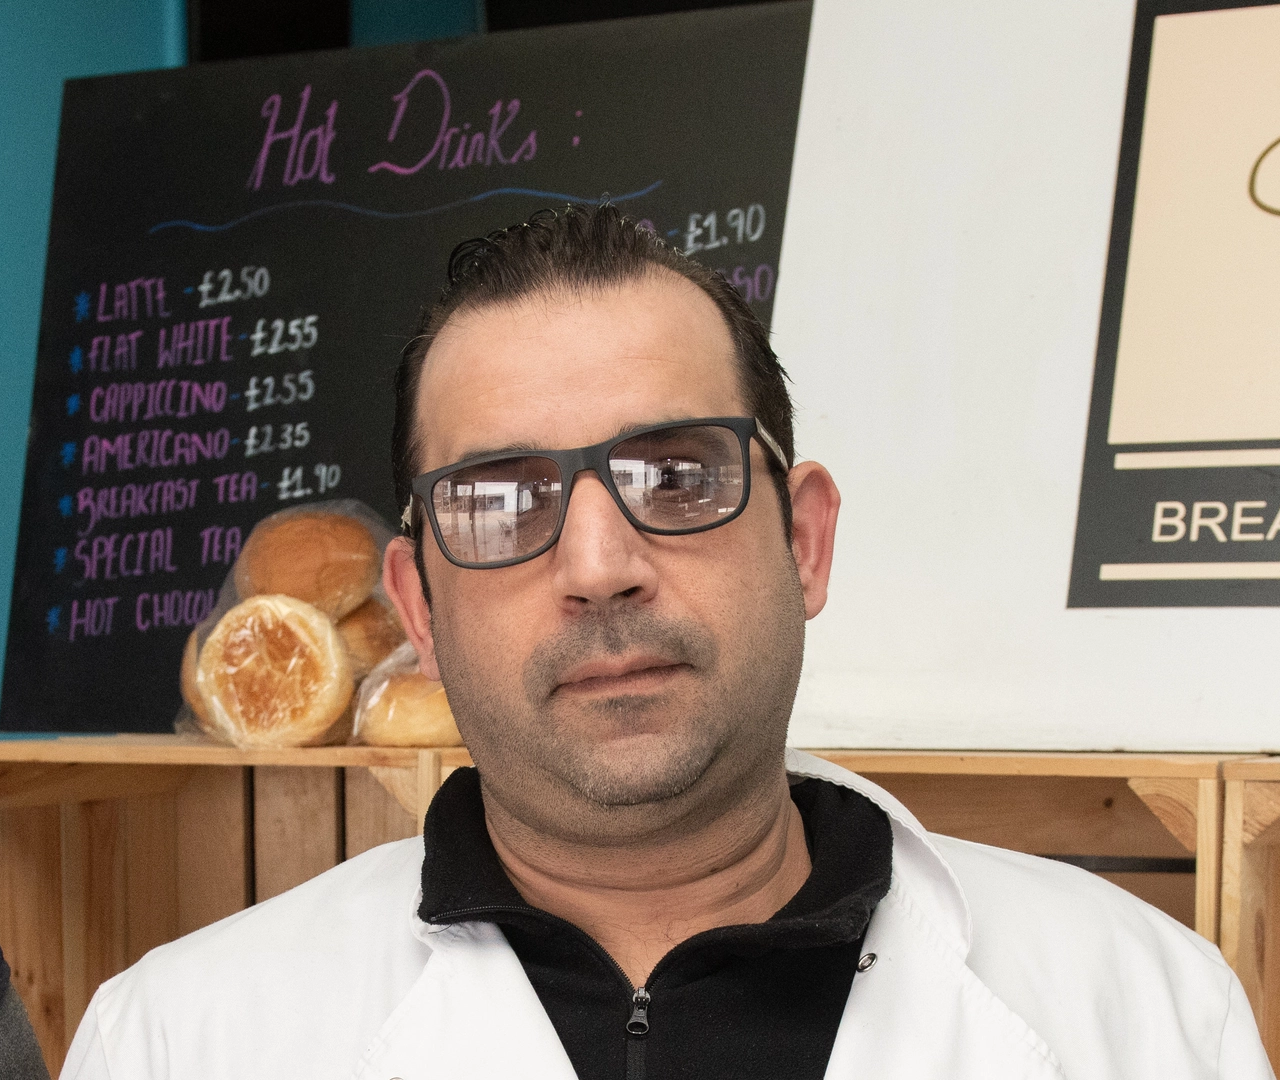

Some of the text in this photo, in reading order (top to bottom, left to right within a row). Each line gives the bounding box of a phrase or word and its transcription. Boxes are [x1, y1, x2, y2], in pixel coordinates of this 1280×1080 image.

[247, 84, 338, 190] Hot
[368, 68, 537, 175] Drinks
[684, 204, 766, 257] £1.90
[97, 266, 270, 322] LATTE £2.50
[157, 316, 233, 369] WHITE
[82, 428, 230, 475] AMERICANO
[75, 478, 200, 537] BREAKFAST
[213, 472, 258, 503] TEA
[74, 526, 243, 580] SPECIAL TEA
[70, 597, 120, 642] HOT
